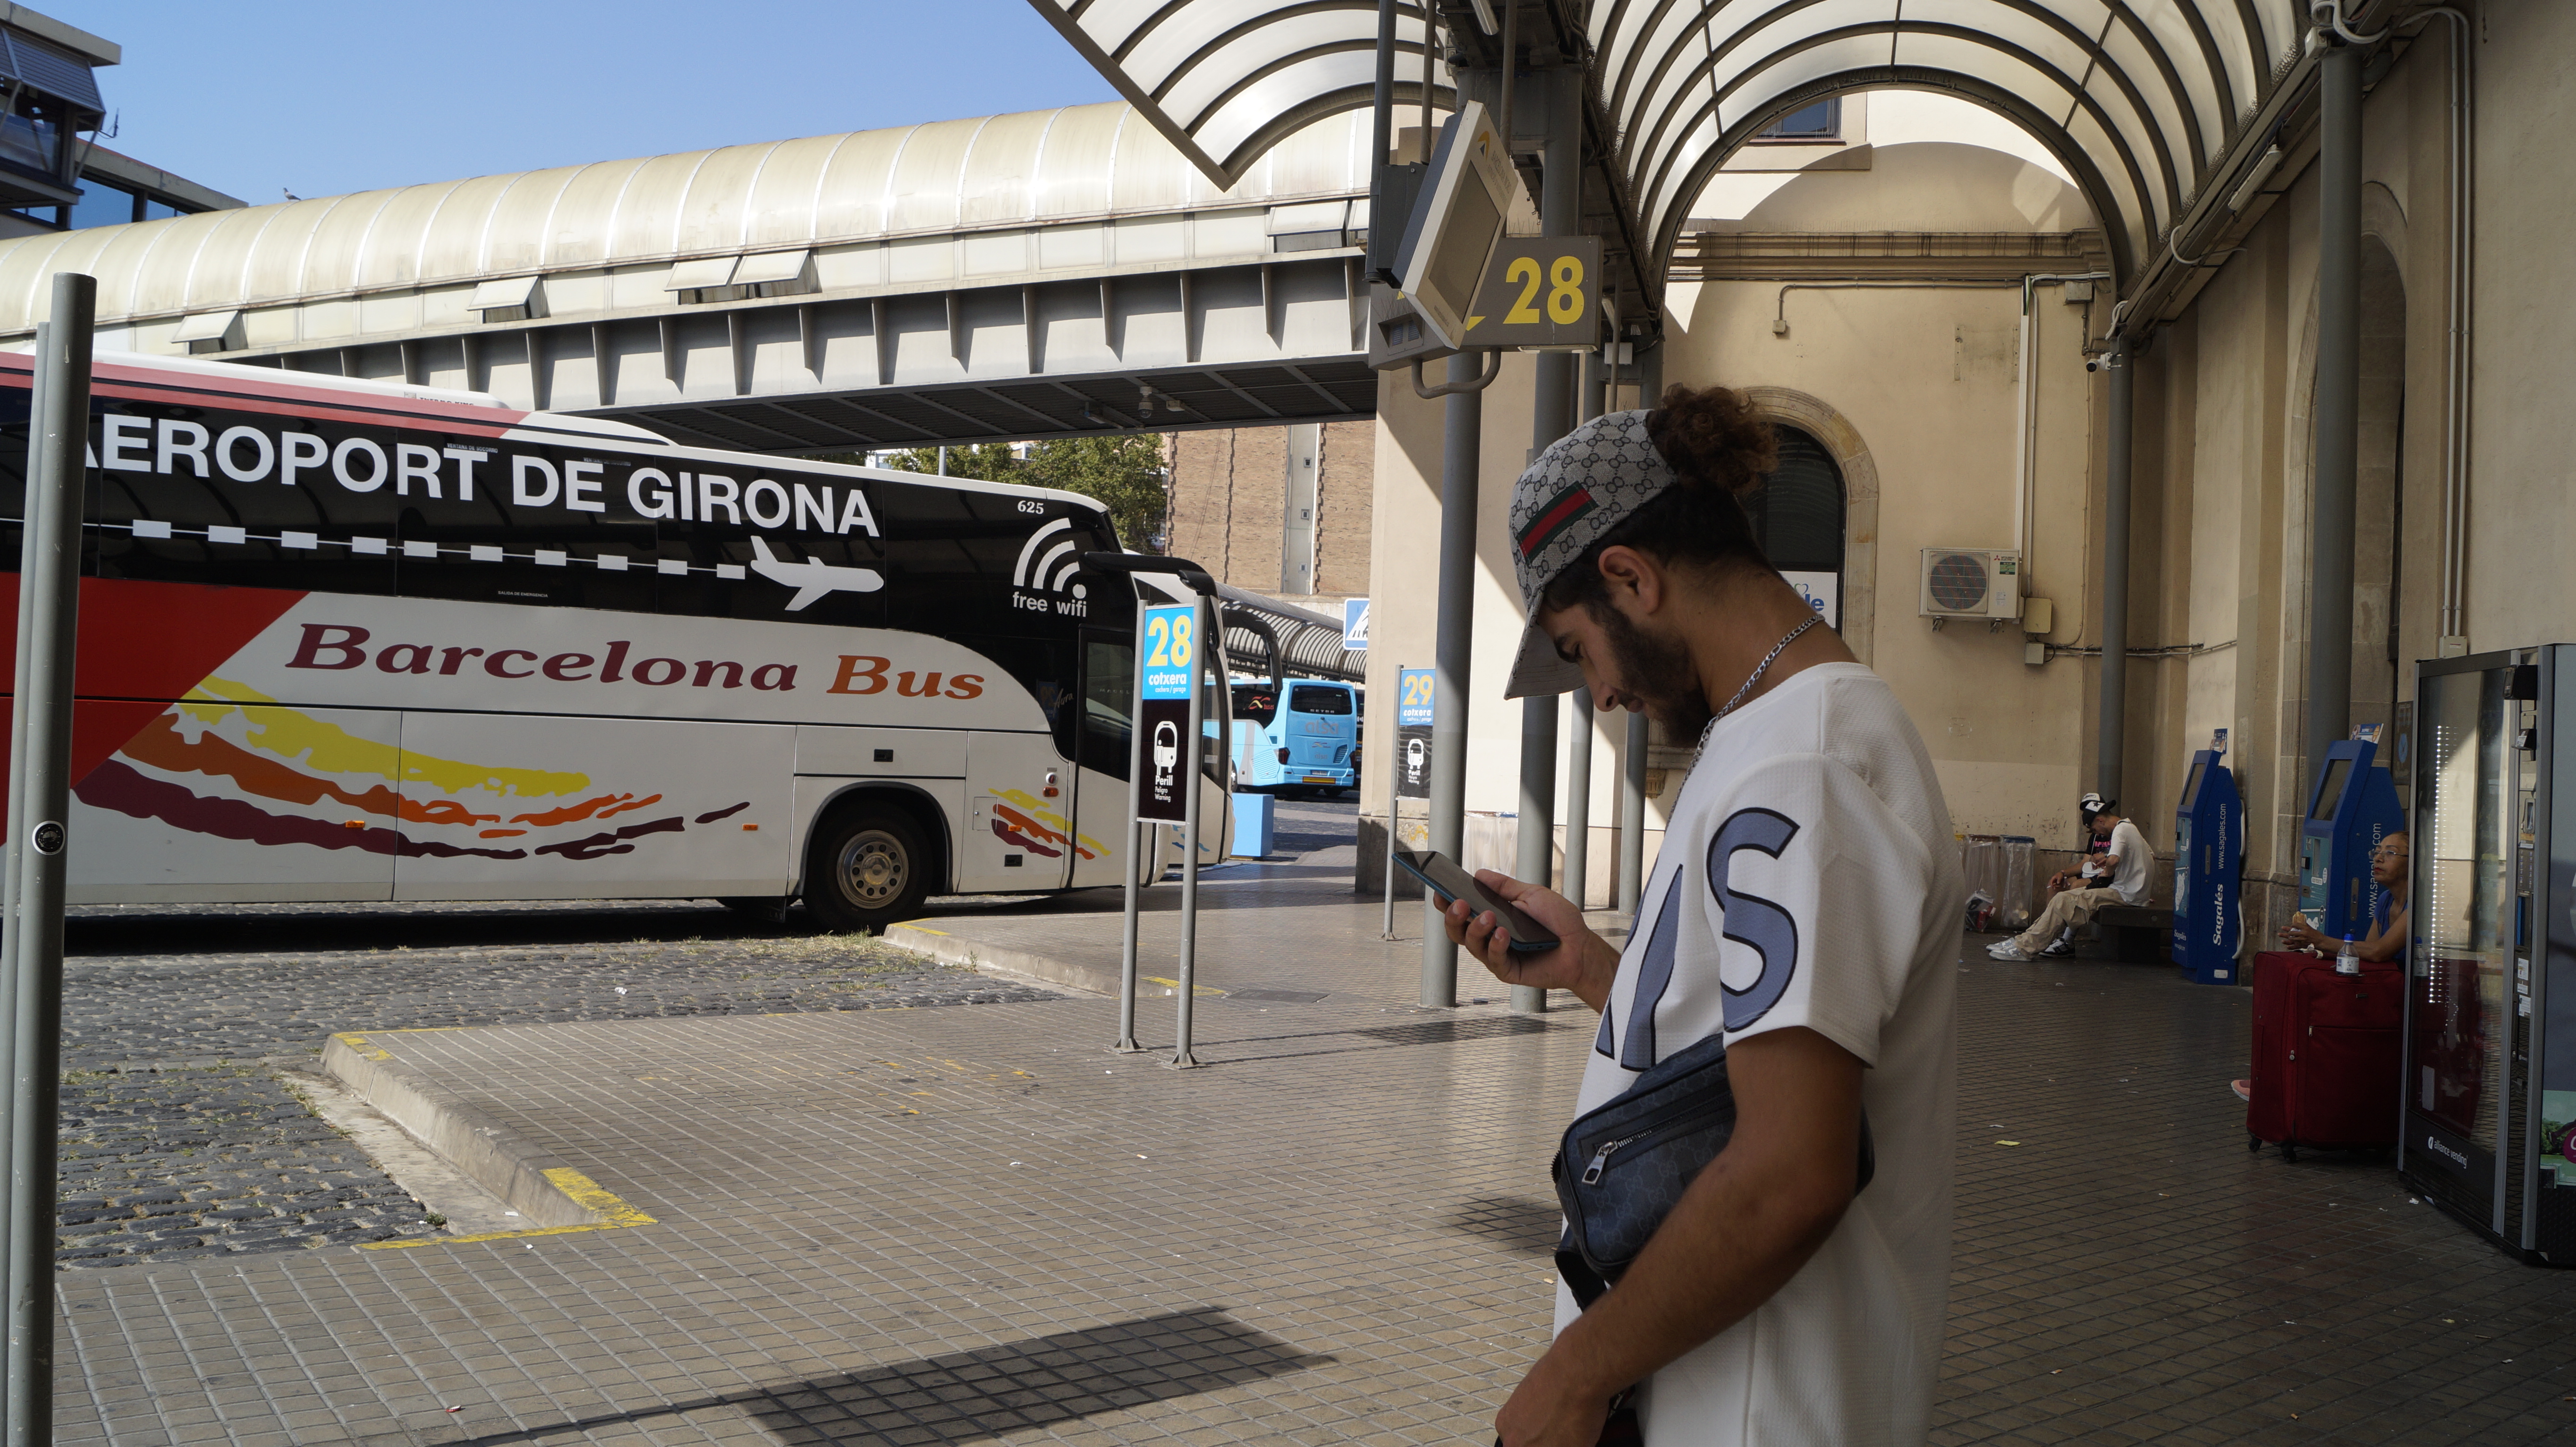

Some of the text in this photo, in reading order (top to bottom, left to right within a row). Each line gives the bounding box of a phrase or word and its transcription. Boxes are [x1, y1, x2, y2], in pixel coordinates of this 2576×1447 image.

[1502, 255, 1585, 325] 28
[85, 413, 880, 537] EROPORT DE GIRONA
[1017, 500, 1044, 514] 625
[1013, 591, 1086, 617] free wifi
[1146, 614, 1192, 667] 28
[286, 624, 984, 700] Barcelona Bus
[1148, 672, 1187, 686] cotxera
[1403, 674, 1433, 706] 29
[1403, 708, 1432, 716] cotxera
[1305, 720, 1339, 734] alsa
[1155, 775, 1173, 786] Perill
[1155, 786, 1169, 795] Peligro
[1154, 793, 1171, 803] Warning
[2218, 803, 2227, 869] www.sagales.com
[2213, 884, 2224, 946] Sagalés
[2434, 1140, 2467, 1169] alliance vending
